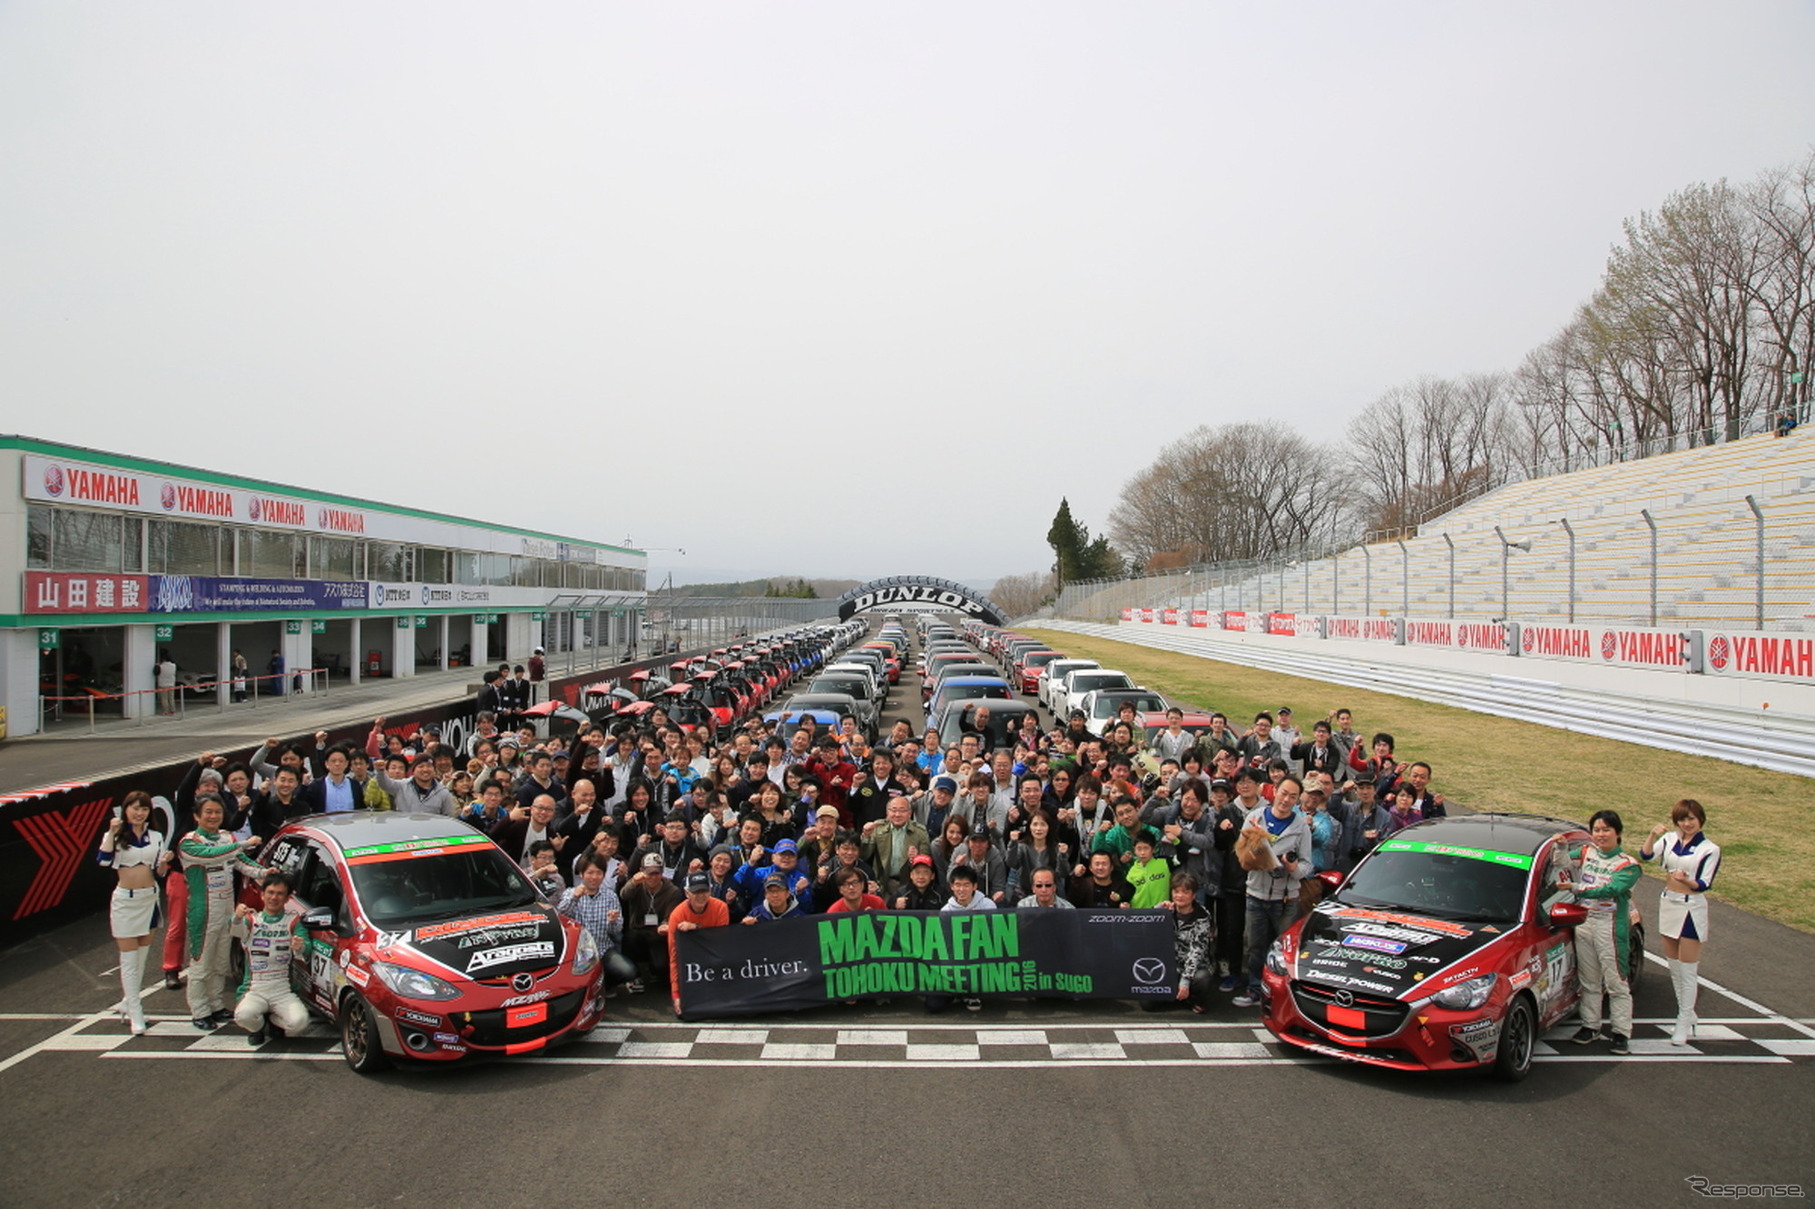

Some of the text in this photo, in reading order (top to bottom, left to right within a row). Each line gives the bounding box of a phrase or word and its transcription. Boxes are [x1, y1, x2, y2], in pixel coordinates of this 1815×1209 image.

[67, 468, 139, 505] YAMAHA
[177, 486, 233, 517] YAMAHA
[262, 499, 305, 526] YAMAHA
[328, 507, 364, 533] YAMAHA
[38, 577, 140, 608] 山田建設
[853, 585, 984, 613] DUNLOP
[42, 631, 57, 643] 31
[157, 627, 172, 638] 32
[288, 622, 300, 631] 33
[312, 622, 325, 630] 34
[1416, 622, 1452, 646] YAMAHA
[1469, 624, 1505, 650] YAMAH
[1536, 627, 1591, 658] YAMAHA
[1732, 636, 1813, 677] YAMAH
[1135, 873, 1166, 886] addas
[817, 912, 1020, 965] MAZDA FAN
[314, 955, 327, 976] 37
[685, 958, 808, 983] Be a driver.
[1552, 957, 1563, 983] 17
[822, 960, 1093, 999] TOHOKU MEETING 2016 in SUGO
[1131, 985, 1172, 994] mazda
[1346, 977, 1394, 994] POWER
[406, 1011, 439, 1024] YOKOHAMA
[1462, 1019, 1493, 1032] YOKOHAMA
[1464, 1030, 1487, 1044] CUSCO
